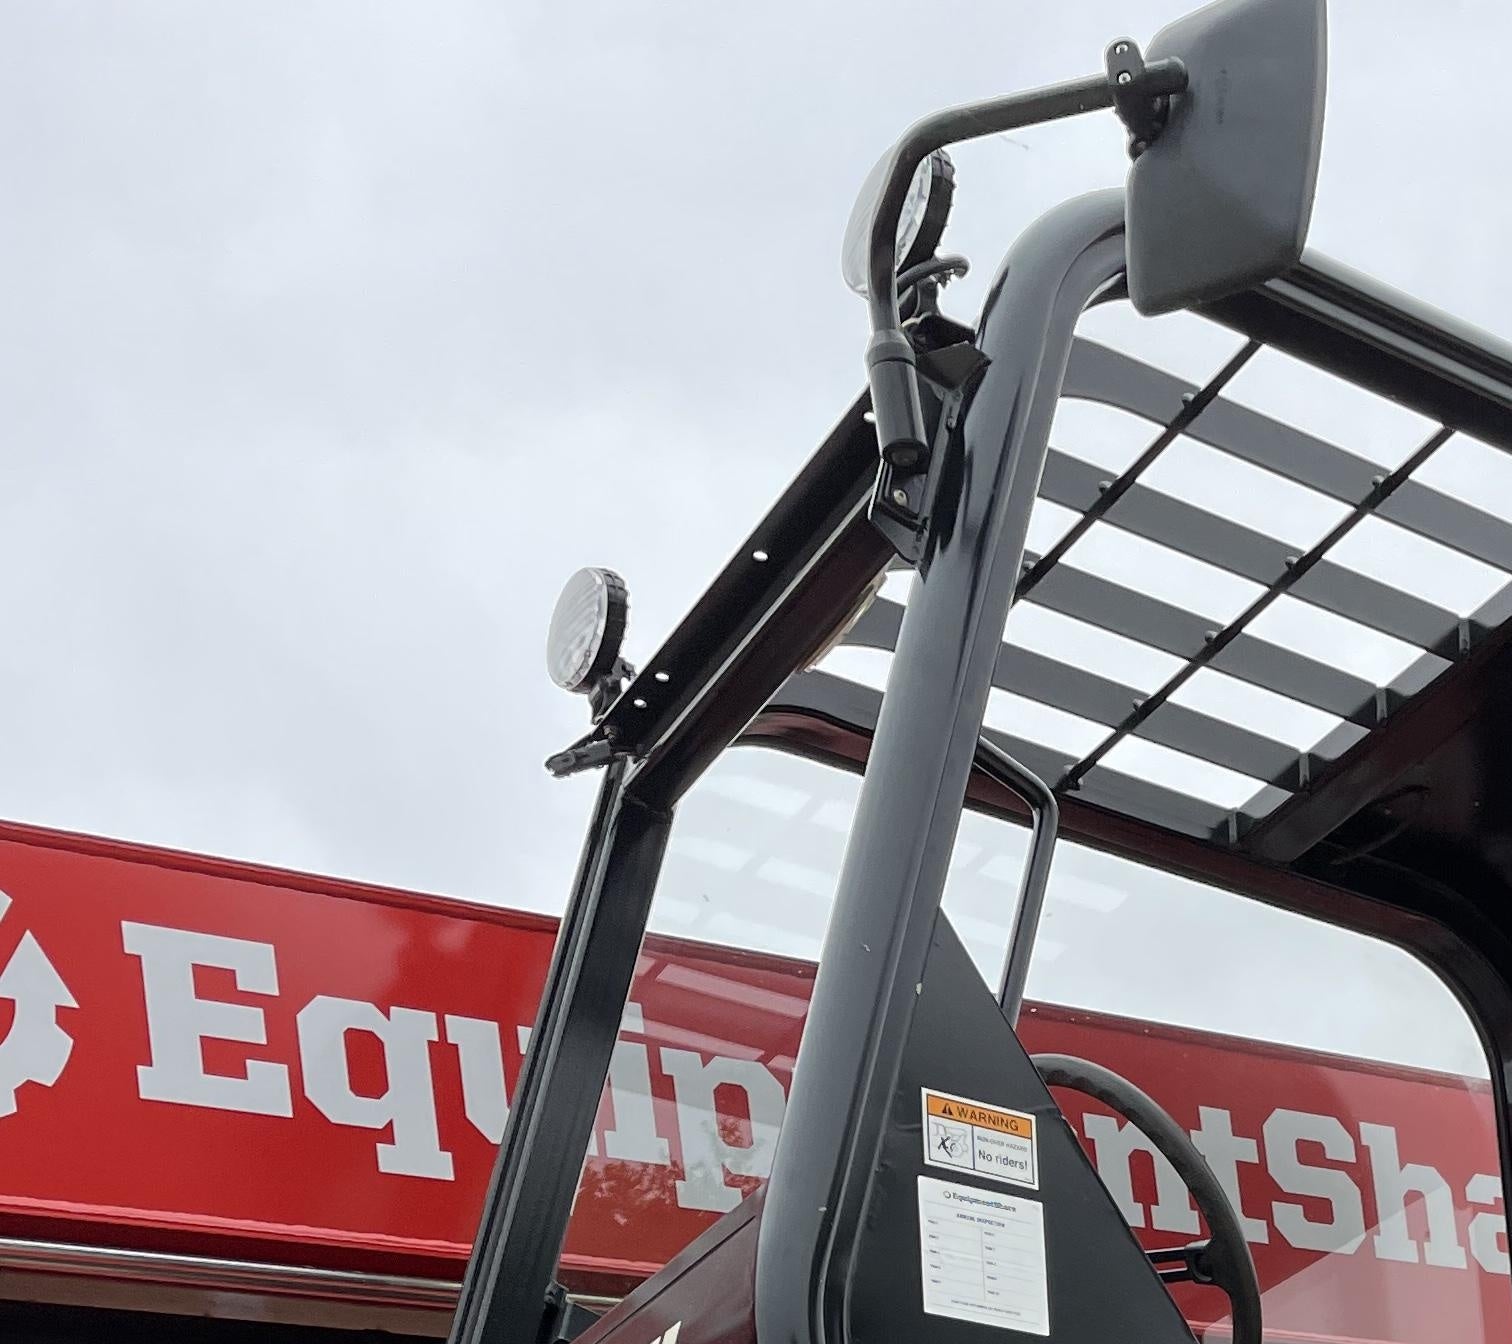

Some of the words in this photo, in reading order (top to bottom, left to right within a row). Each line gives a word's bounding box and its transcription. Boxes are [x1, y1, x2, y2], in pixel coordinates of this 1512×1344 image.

[956, 1106, 1019, 1132] WARNING
[978, 1149, 993, 1163] No
[995, 1154, 1028, 1171] riders!
